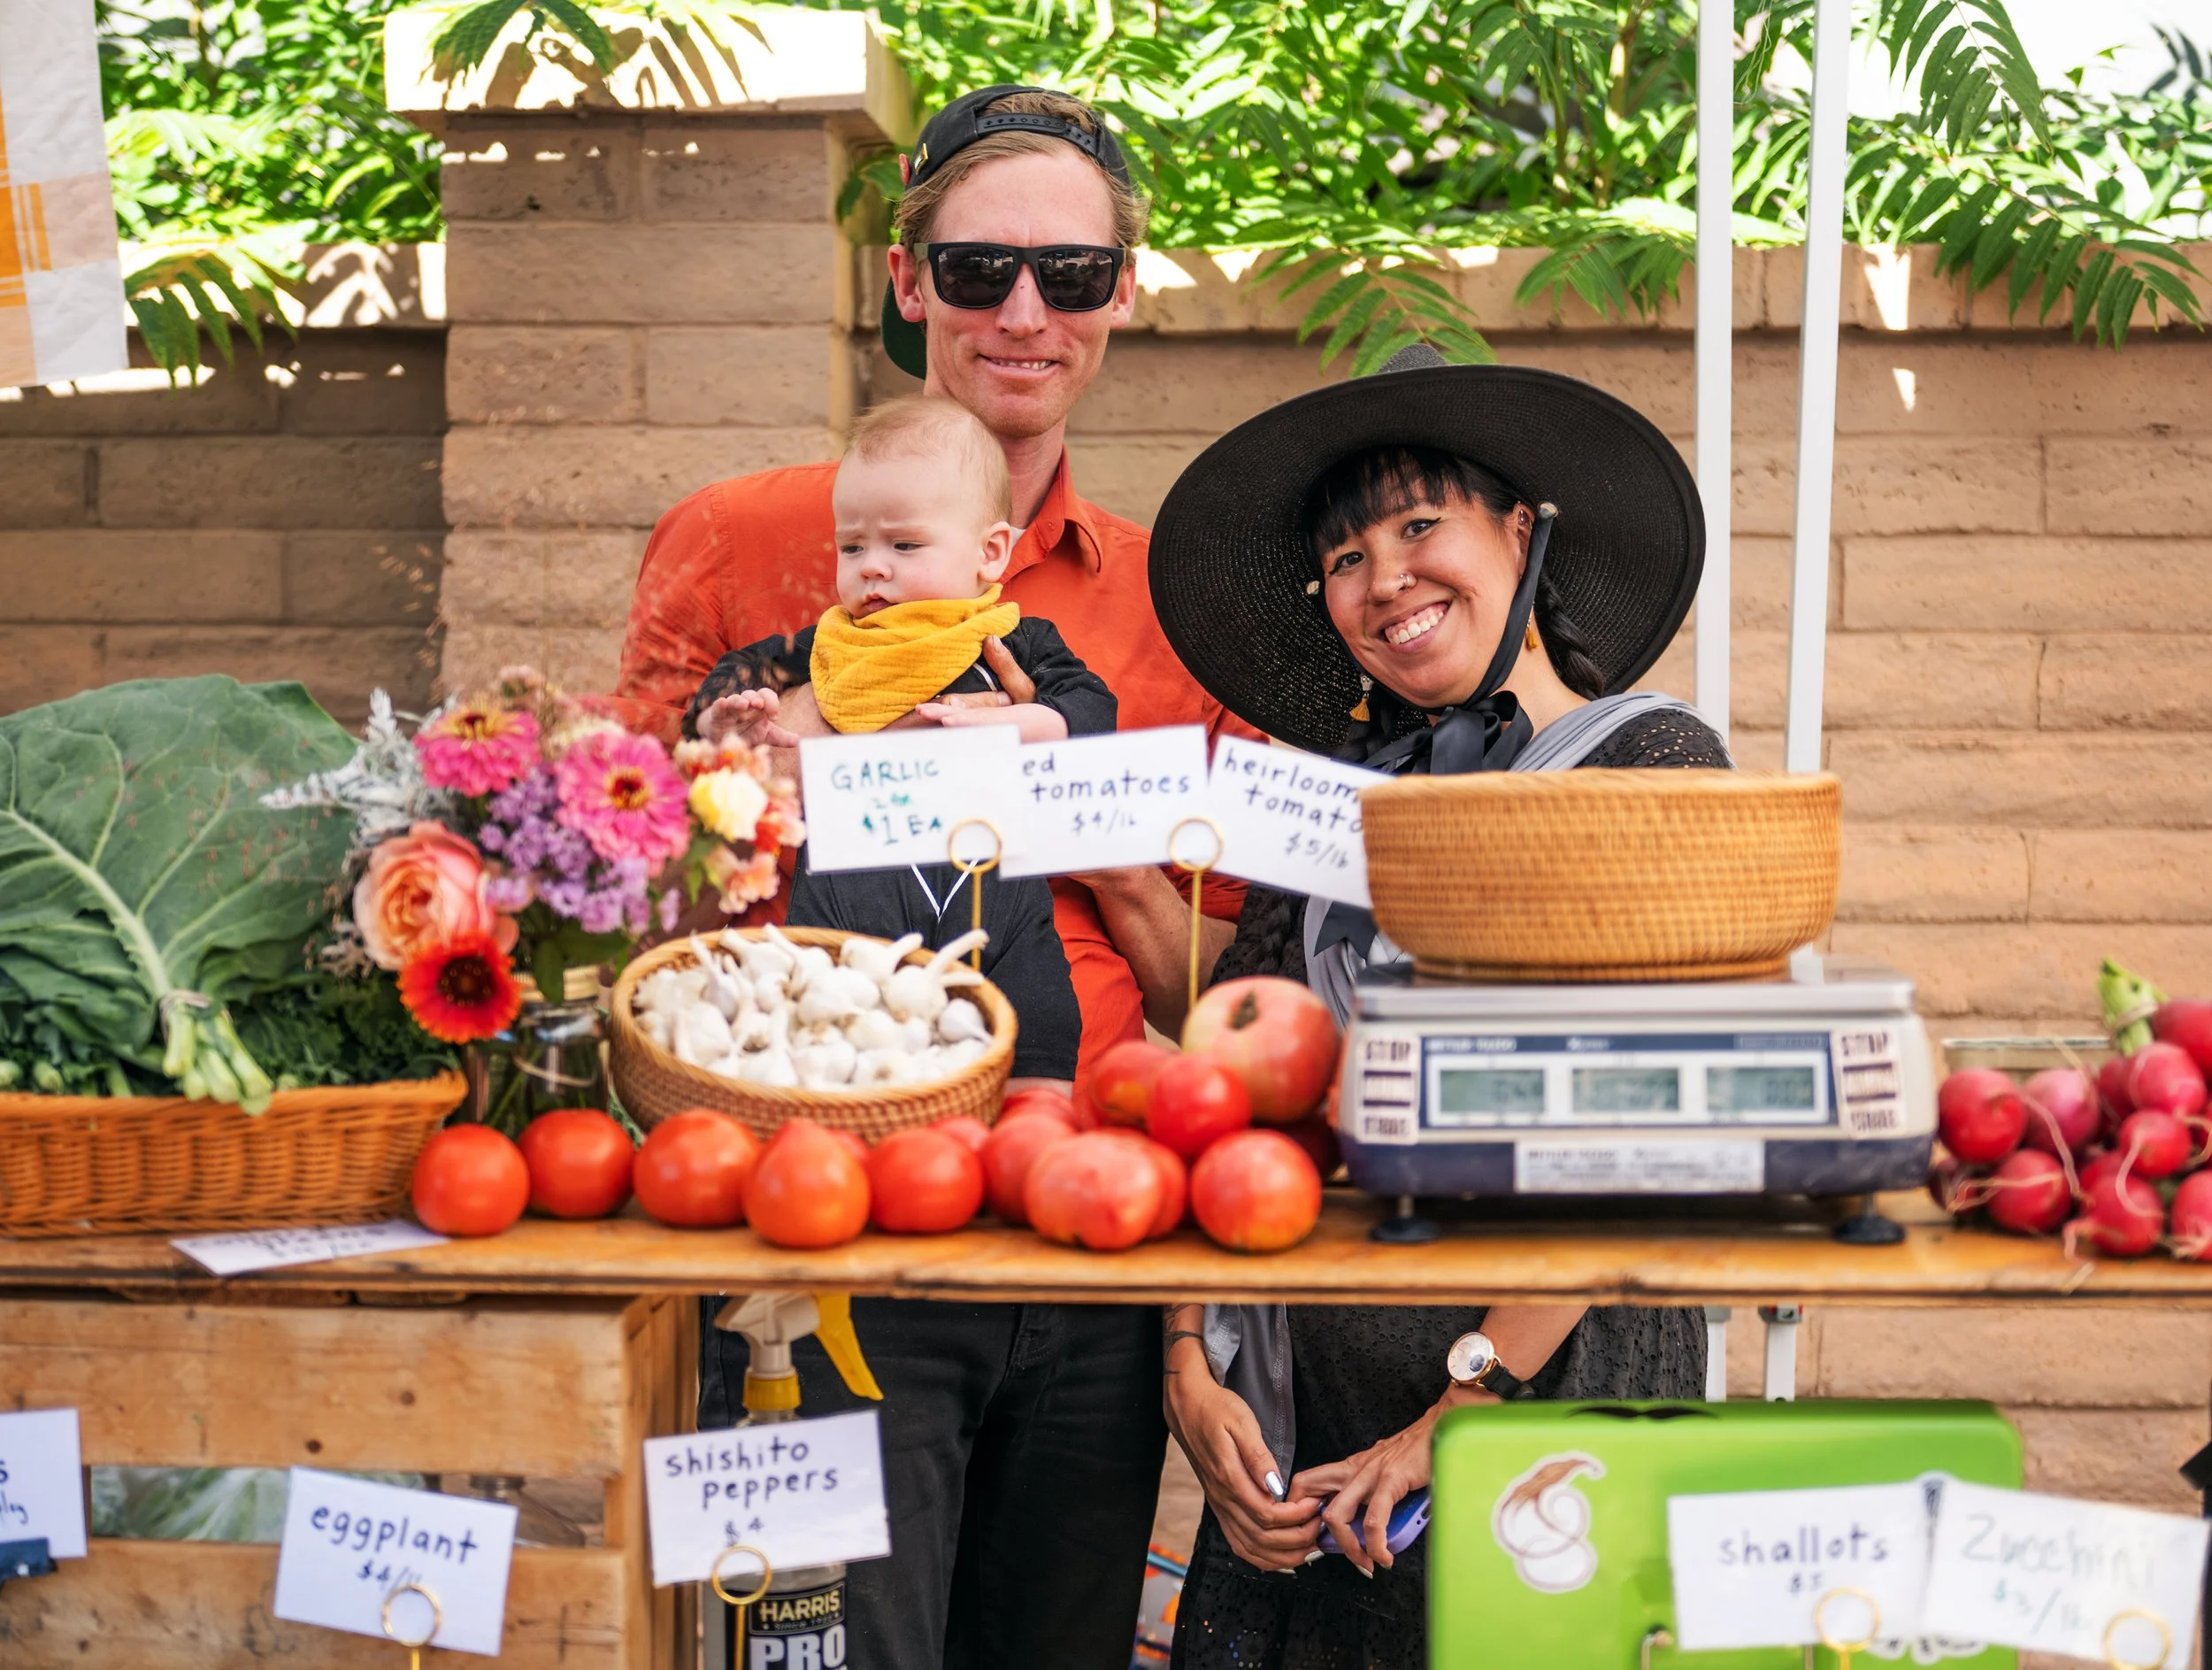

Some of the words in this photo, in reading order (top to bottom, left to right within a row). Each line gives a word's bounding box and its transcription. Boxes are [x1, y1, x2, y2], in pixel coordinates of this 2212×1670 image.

[830, 758, 939, 791] GARLIC
[1031, 768, 1190, 803] tomatoes
[1225, 747, 1361, 804] heirloom
[666, 1434, 810, 1477] shishito
[702, 1467, 839, 1511] peppers
[310, 1506, 479, 1564] eggplant
[1717, 1521, 1890, 1566] shallots
[760, 1589, 841, 1622] HARRIS
[749, 1623, 846, 1670] PRO
